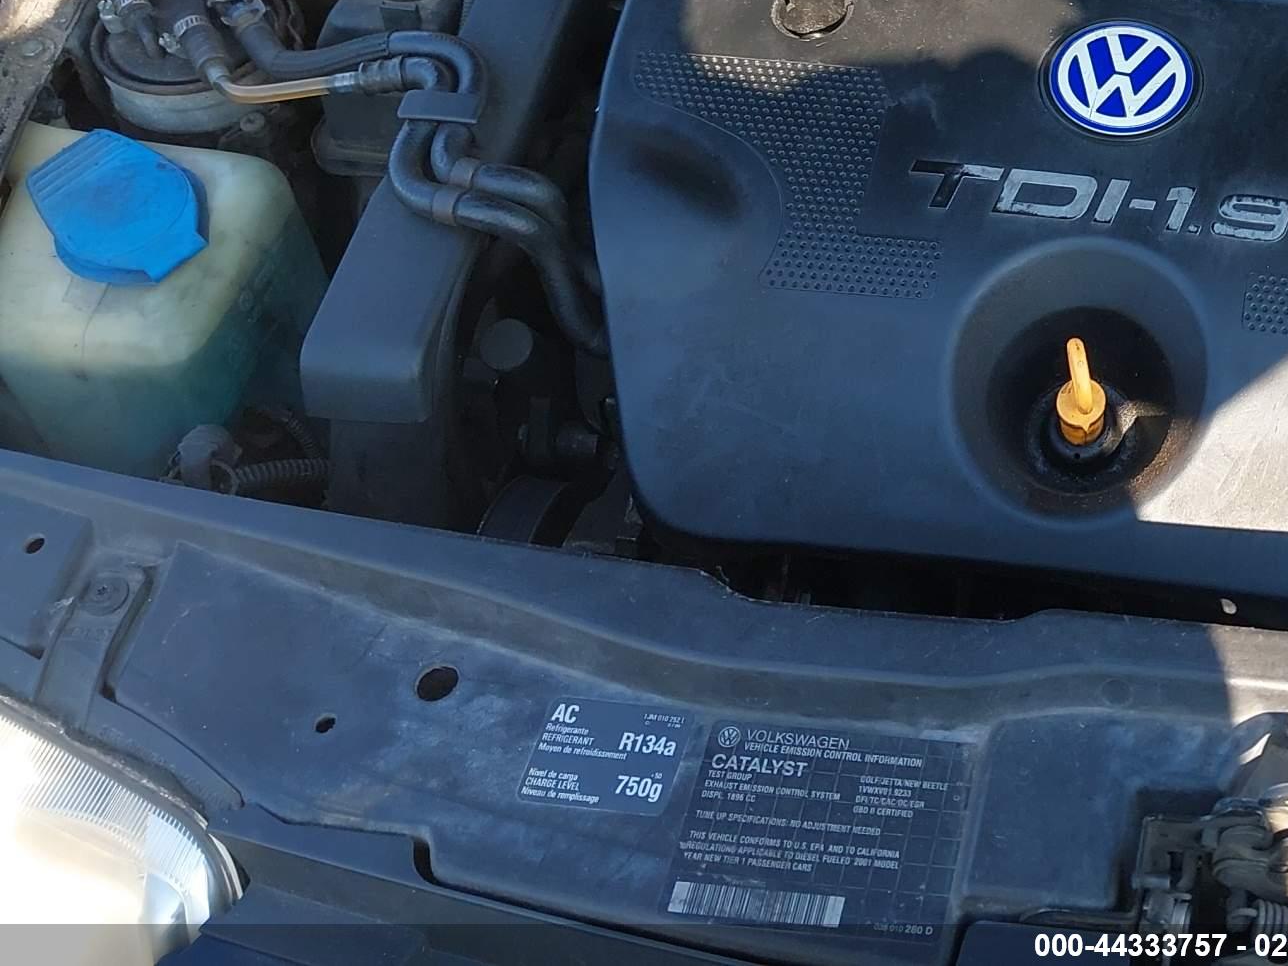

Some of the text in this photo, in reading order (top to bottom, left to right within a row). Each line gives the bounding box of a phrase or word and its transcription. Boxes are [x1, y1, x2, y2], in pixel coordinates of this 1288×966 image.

[551, 704, 580, 724] AC
[545, 723, 589, 736] Refrigerante
[542, 733, 595, 746] REFRIGERANT
[619, 732, 677, 756] R134a
[746, 729, 850, 750] VOLKSWAGEN
[538, 742, 628, 760] Moyen de refroidissement
[744, 741, 923, 768] VEHICLE EMISSION CONTROL INFORMATION
[529, 768, 579, 782] Nivel de carga
[708, 769, 753, 781] TEST GROUP
[711, 753, 809, 778] CATALYST
[525, 777, 580, 791] CHARGE LEVEL
[615, 775, 663, 803] 750g
[704, 780, 841, 801] EXHAUST EMISSION CONTROL SYSTEM
[922, 781, 949, 791] BEETLE
[521, 786, 600, 805] Niveau de remplissage
[876, 807, 914, 818] CERTIFIED
[696, 809, 715, 820] TUNE
[716, 812, 727, 820] UP
[802, 820, 852, 834] ADJUSTMENT
[852, 826, 881, 836] NEEDED
[690, 830, 706, 840] THIS
[708, 832, 737, 843] VEHICLE
[740, 835, 781, 847] CONFORMS
[783, 839, 793, 848] TO
[828, 844, 844, 853] AND
[845, 846, 855, 854] TO
[856, 847, 900, 859] CALIFORNIA
[704, 853, 721, 862] NEW
[747, 858, 791, 870] PASSENGER
[791, 861, 813, 872] CARS
[737, 845, 782, 859] APPLICABLE
[784, 850, 795, 860] TO
[795, 852, 820, 862] DIESEL
[873, 859, 899, 870] MODEL
[925, 925, 934, 936] D
